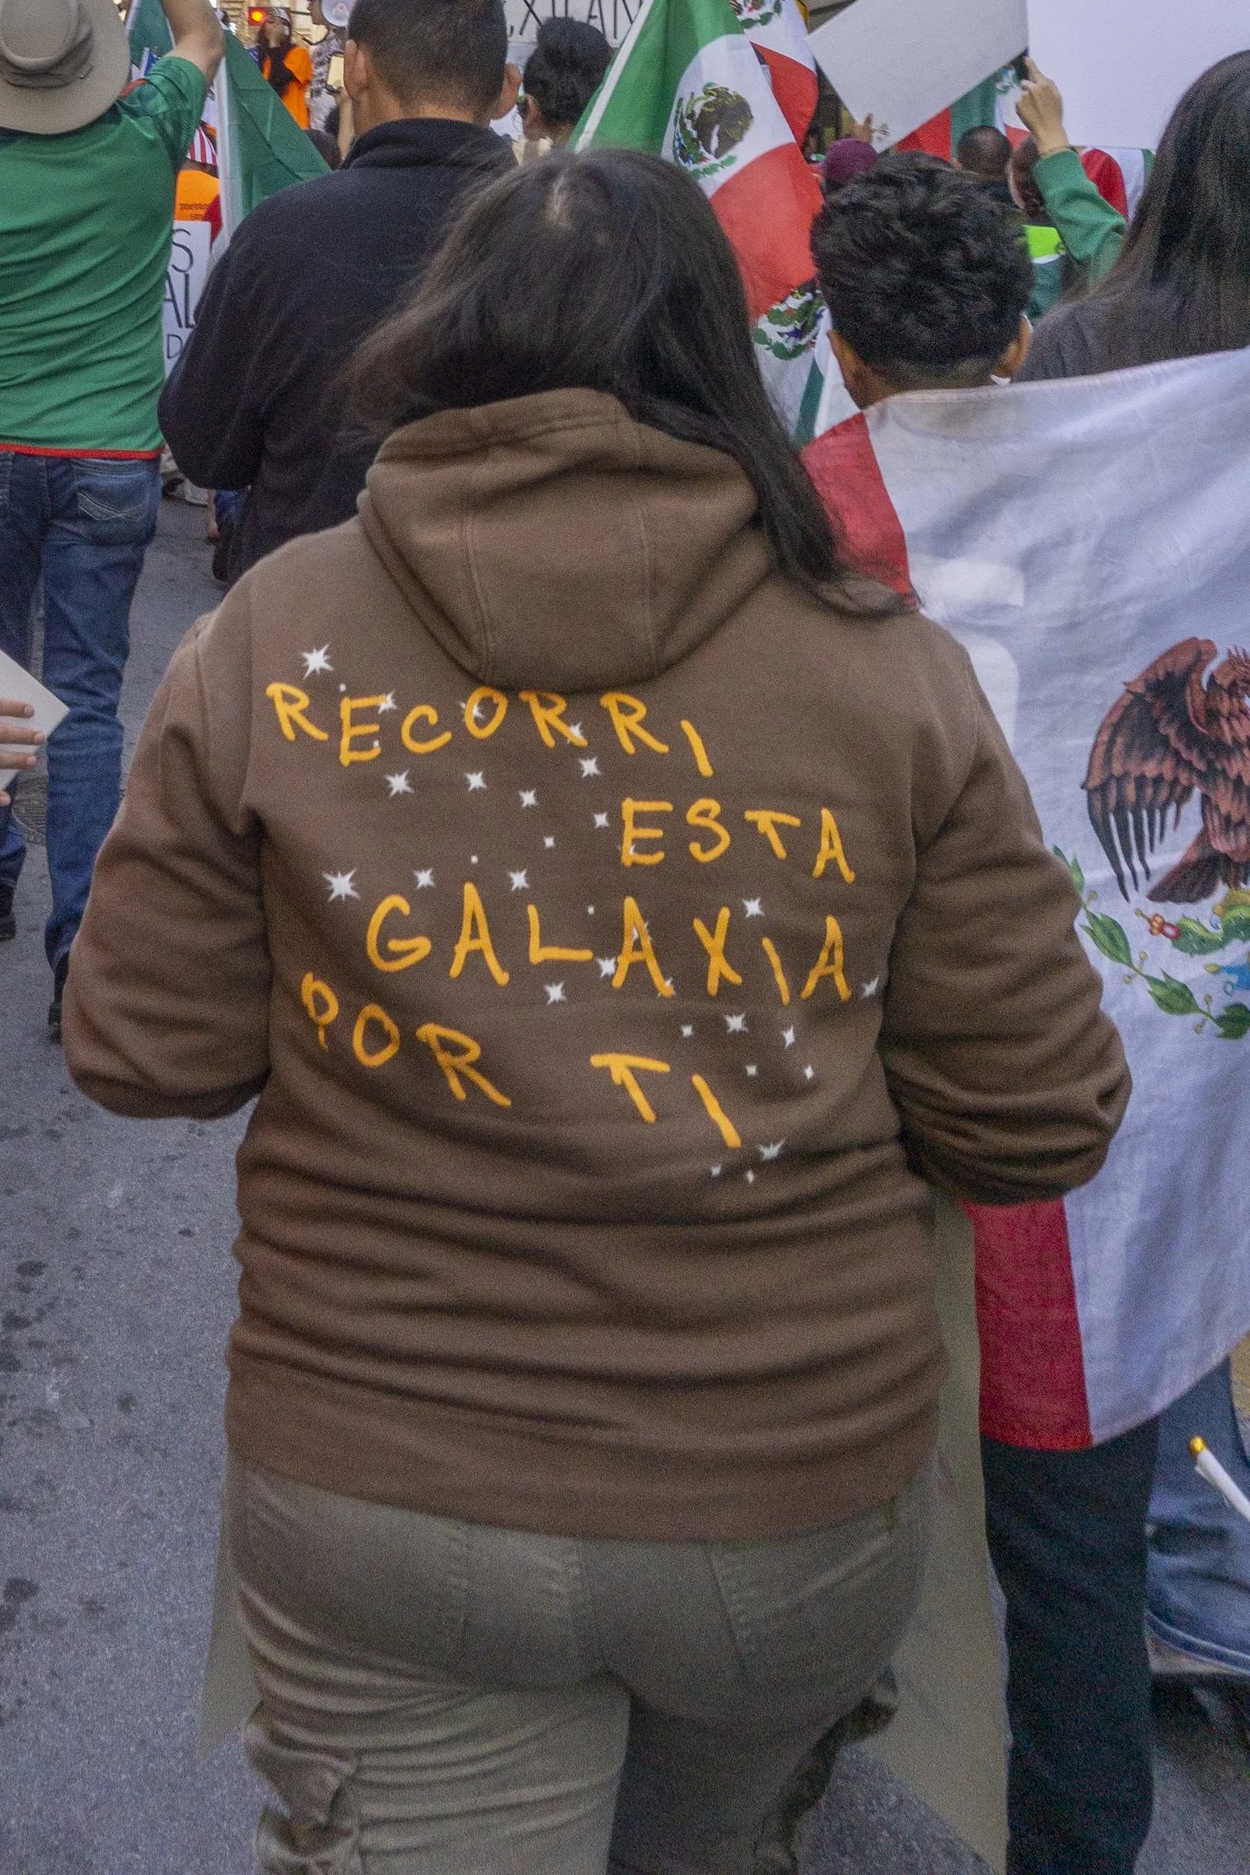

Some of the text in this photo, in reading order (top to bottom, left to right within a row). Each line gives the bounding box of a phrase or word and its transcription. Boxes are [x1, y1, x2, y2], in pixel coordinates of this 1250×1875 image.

[266, 681, 714, 778] RECORRI
[620, 797, 856, 884] ESTA
[365, 881, 853, 1006] GALAXIA
[300, 971, 742, 1149] POR TI
